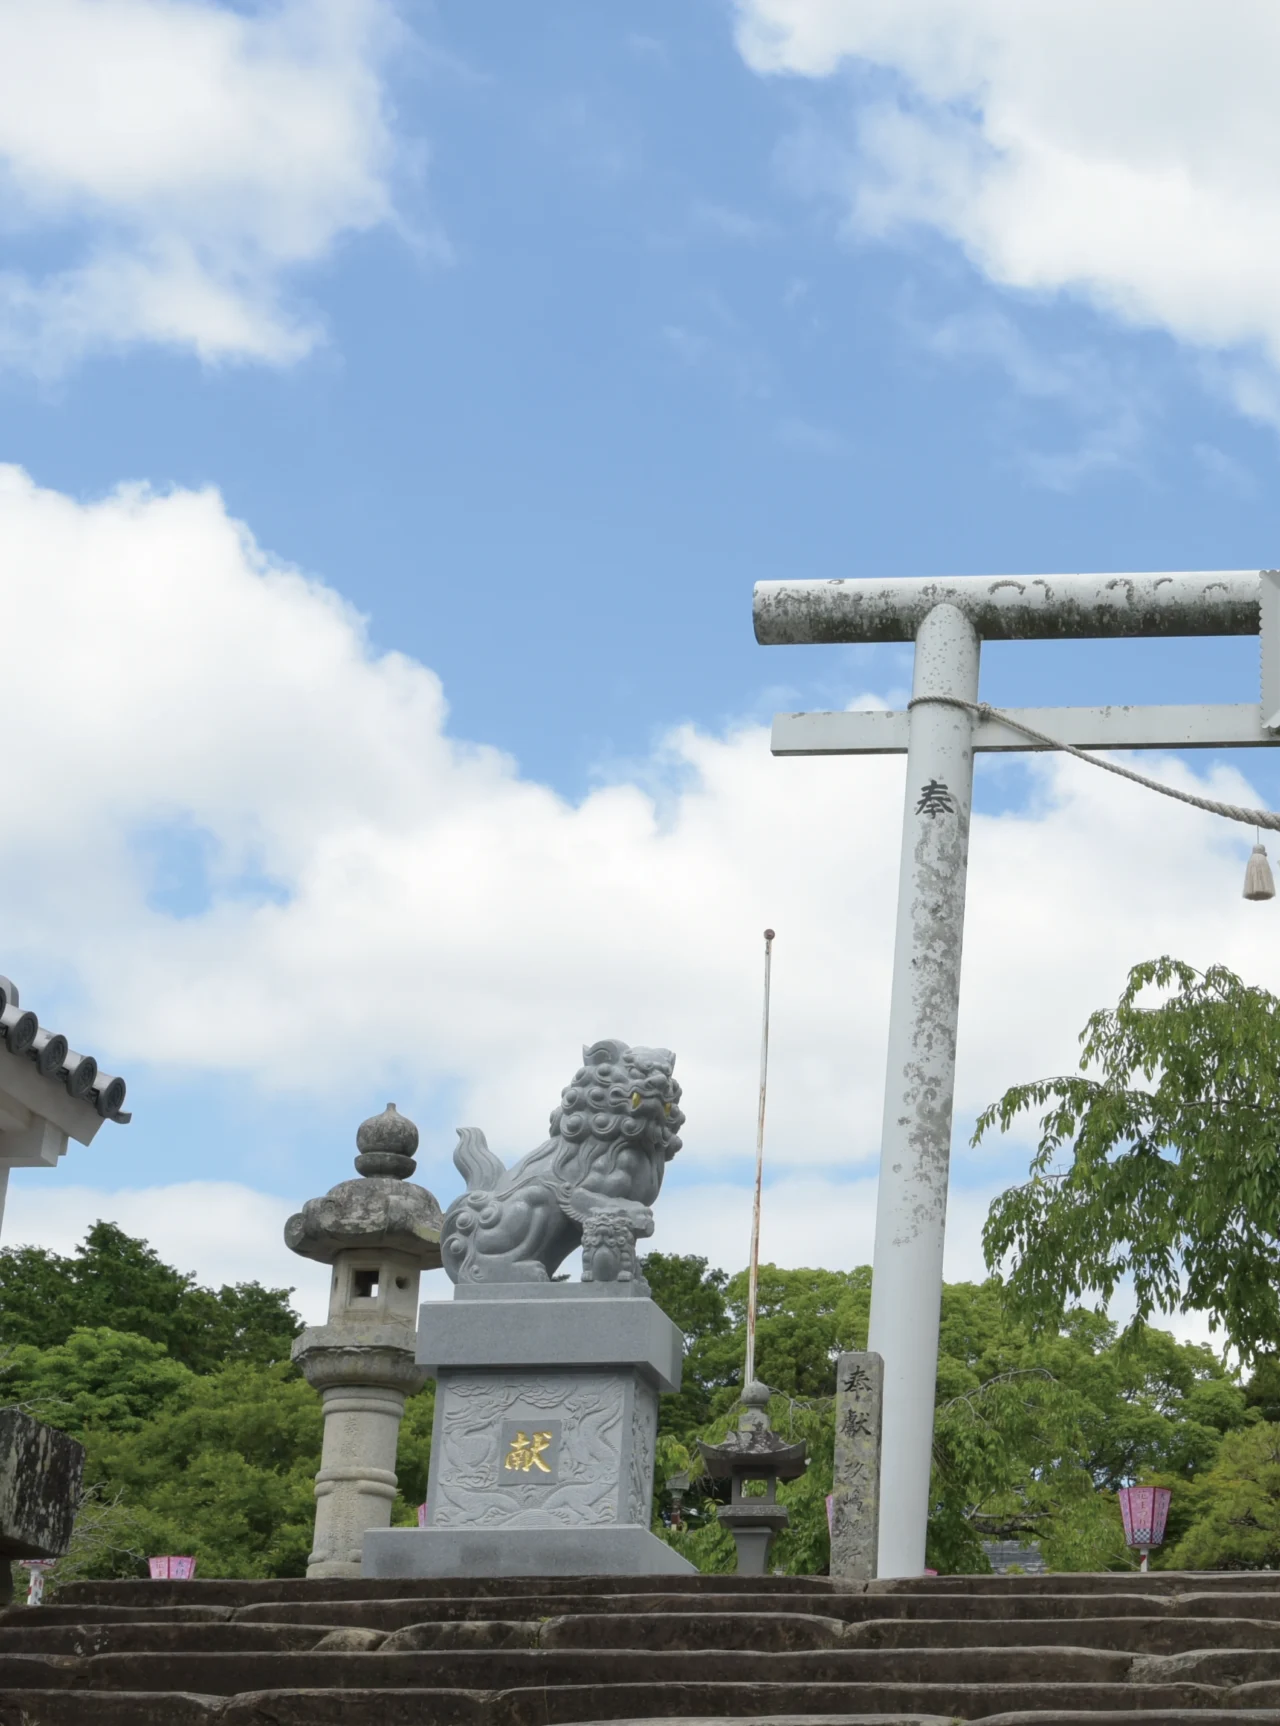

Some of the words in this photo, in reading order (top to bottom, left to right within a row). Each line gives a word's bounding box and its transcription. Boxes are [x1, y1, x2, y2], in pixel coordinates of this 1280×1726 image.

[915, 779, 954, 819] 奉
[504, 1430, 553, 1473] 献
[1137, 1489, 1148, 1526] 花まつり
